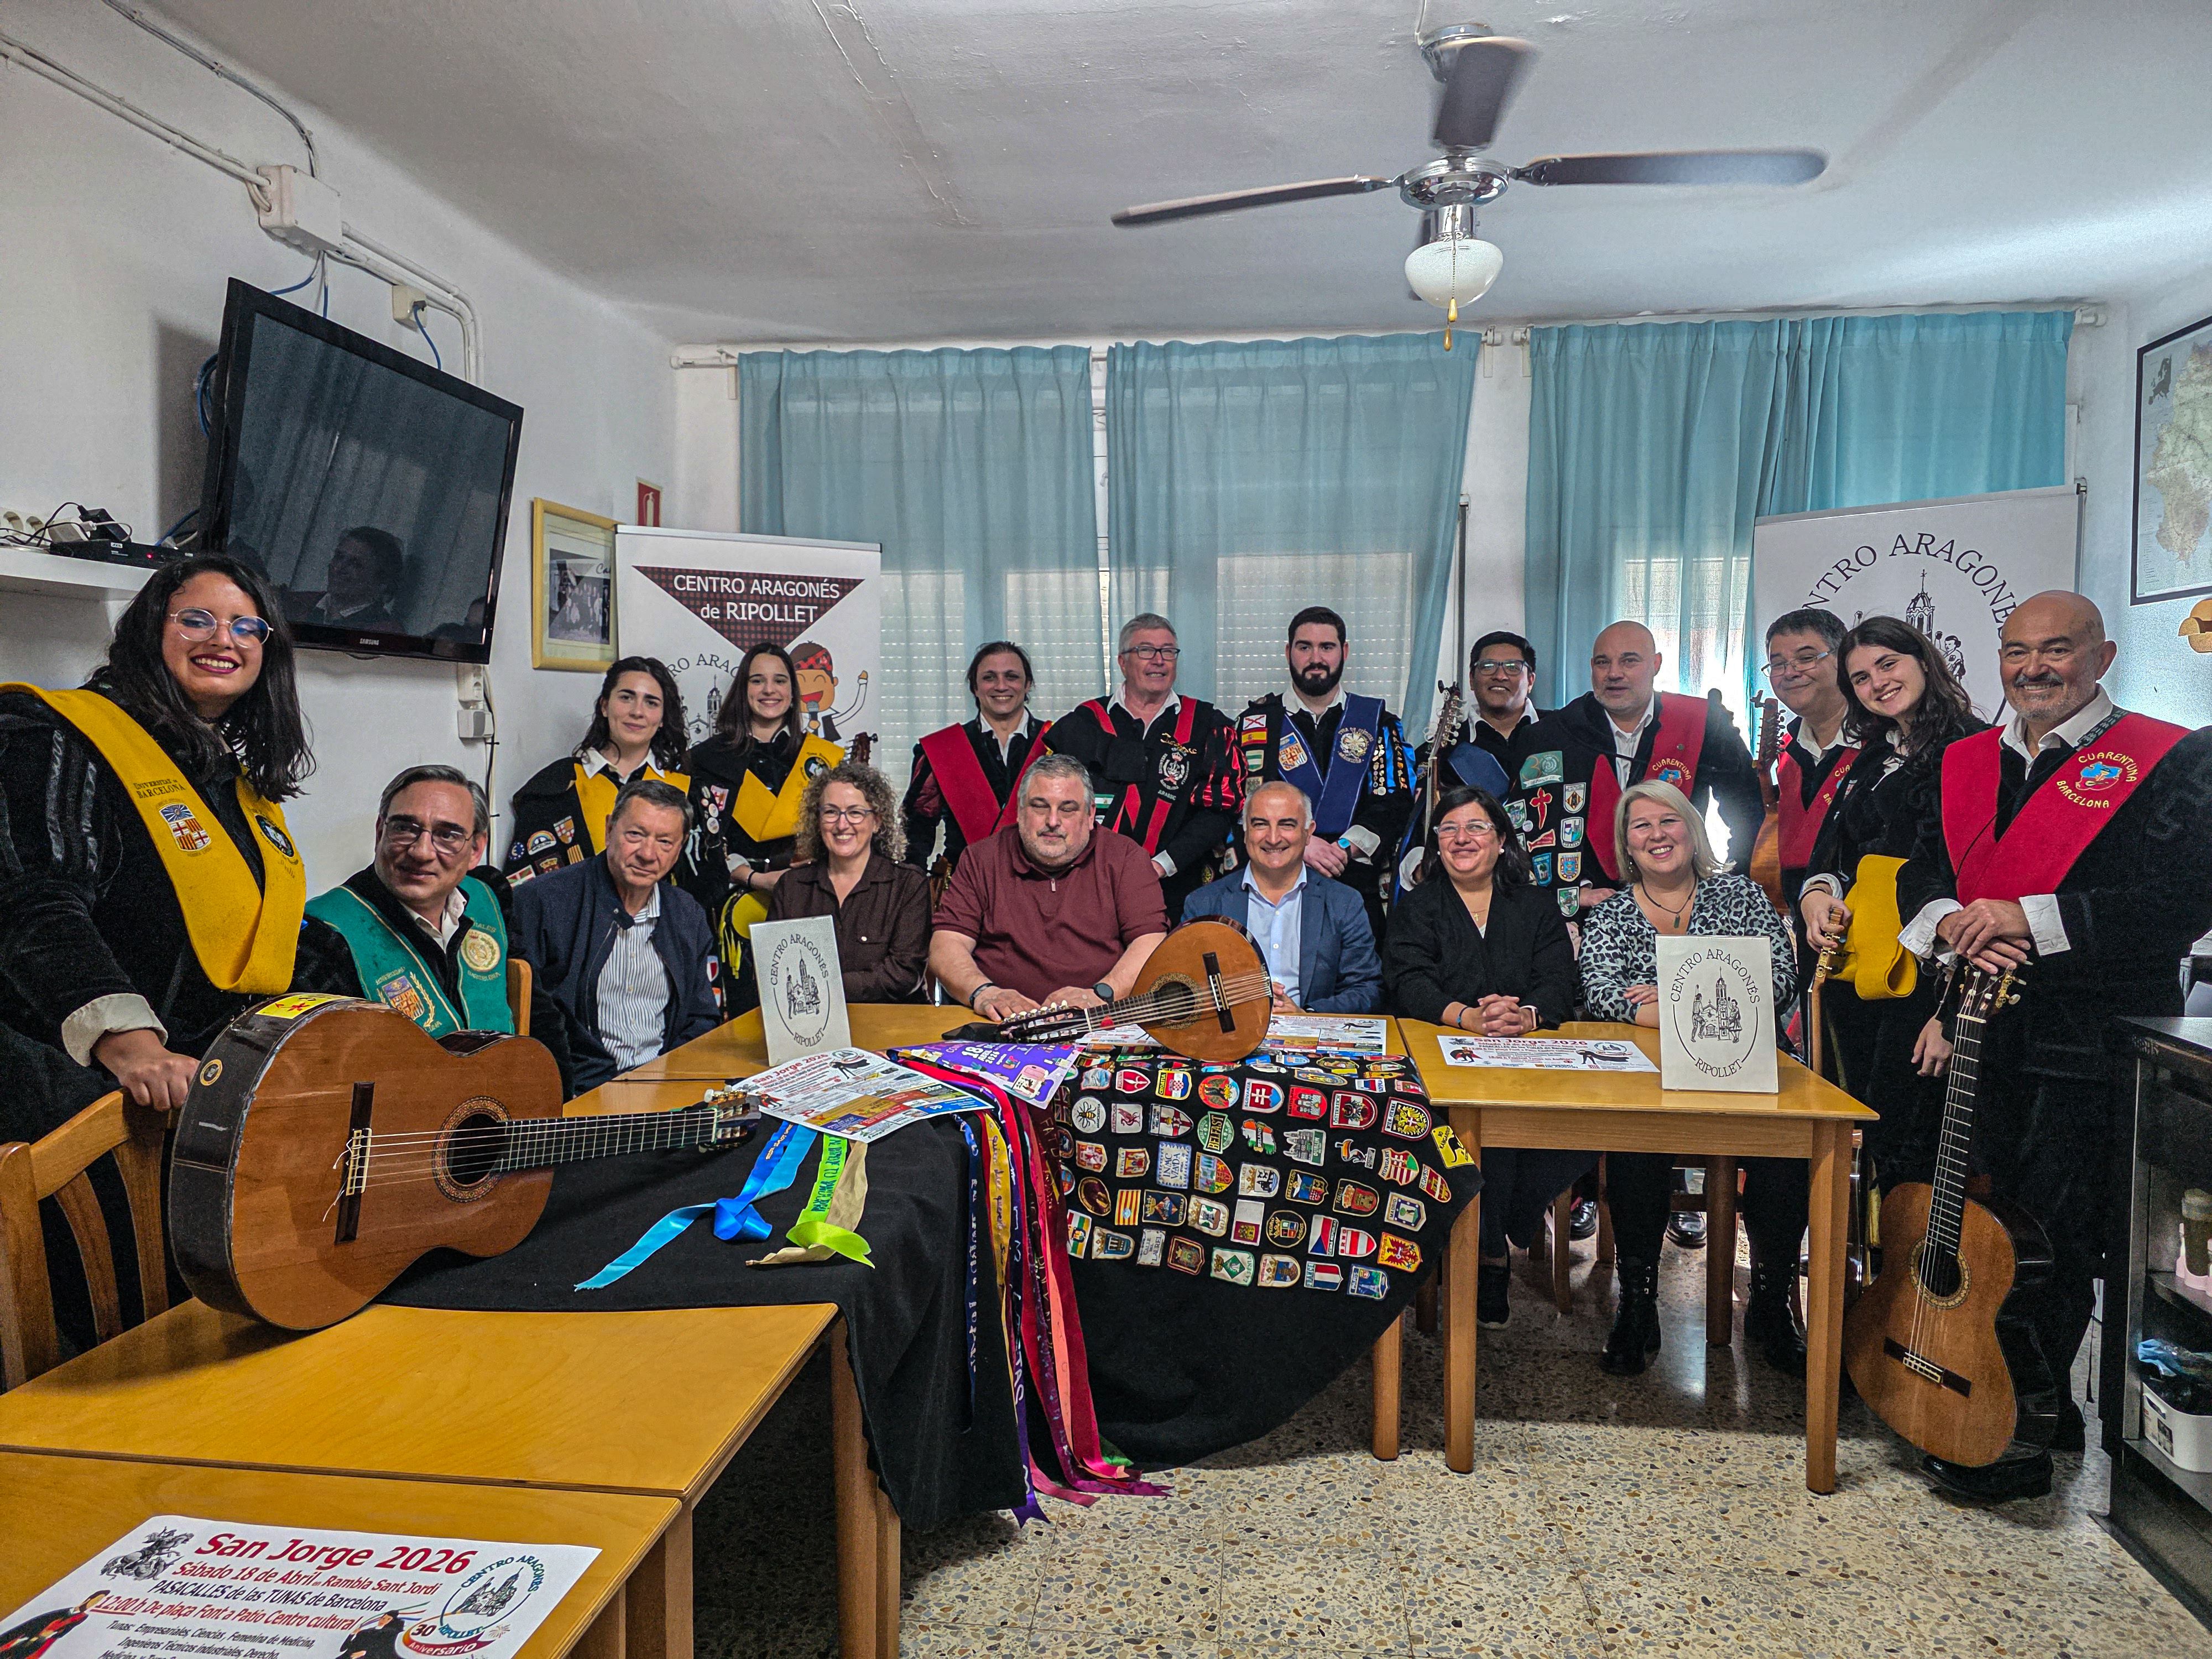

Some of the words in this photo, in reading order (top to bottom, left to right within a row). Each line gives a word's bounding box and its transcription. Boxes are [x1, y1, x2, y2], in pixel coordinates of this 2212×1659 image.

[674, 575, 745, 594] CENTRO
[750, 578, 839, 598] ARAGONÉS
[1888, 533, 2018, 636] ARAGONE
[701, 604, 720, 619] de
[727, 602, 817, 623] RIPOLLET
[1652, 758, 1692, 780] CUARENTUNA
[2078, 752, 2138, 782] CUARENTUNA
[137, 784, 186, 799] BARCELONA
[2056, 780, 2109, 808] BARCELONA
[770, 938, 787, 985] CENTRO
[1670, 952, 1702, 1002] CENTRO
[1707, 948, 1760, 1004] ARAGONÉS
[794, 1027, 824, 1047] RIPOLLET
[962, 1047, 984, 1058] 18
[752, 1074, 773, 1084] San
[774, 1061, 802, 1077] Jorge
[1695, 1057, 1743, 1077] RIPOLLET
[1386, 1103, 1396, 1129] WIEN-VIENNA
[1208, 1115, 1224, 1150] BELFAST
[1381, 1151, 1390, 1177] HUNGARY
[1420, 1167, 1429, 1189] BUDAPEST
[1143, 1238, 1151, 1255] CALLE
[1152, 1237, 1161, 1261] LAUREL
[1306, 1264, 1314, 1286] FRANCE
[195, 1533, 270, 1558] San
[265, 1538, 374, 1571] Jorge
[374, 1546, 479, 1574] 2026
[172, 1561, 233, 1579] Sábado
[231, 1566, 260, 1580] 18
[253, 1568, 279, 1582] de
[274, 1570, 322, 1585] Abril
[322, 1575, 373, 1589] Rambla
[371, 1579, 407, 1593] Sant
[403, 1582, 444, 1595] Jordi
[461, 1557, 514, 1588] CENTRO
[147, 1580, 233, 1599] PASACALLES
[224, 1585, 244, 1600] de
[242, 1587, 267, 1601] las
[263, 1589, 311, 1604] TUNAS
[305, 1592, 326, 1606] de
[322, 1594, 388, 1611] Barcelona
[94, 1595, 140, 1611] 12:00
[132, 1598, 149, 1612] h
[142, 1600, 160, 1614] De
[154, 1601, 197, 1620] plaça
[193, 1604, 229, 1620] Font
[222, 1609, 236, 1620] a
[231, 1608, 267, 1624] Patio
[263, 1610, 308, 1627] Centro
[306, 1613, 364, 1631] cultural
[106, 1620, 135, 1631] Tunas:
[134, 1623, 191, 1639] Empresariales,
[227, 1631, 269, 1645] Femenina
[267, 1634, 280, 1645] de
[277, 1635, 316, 1650] Medicina,
[411, 1624, 437, 1636] 30
[117, 1636, 162, 1650] Ingenieros
[160, 1640, 197, 1653] Técnicos
[409, 1640, 478, 1656] Aniversario
